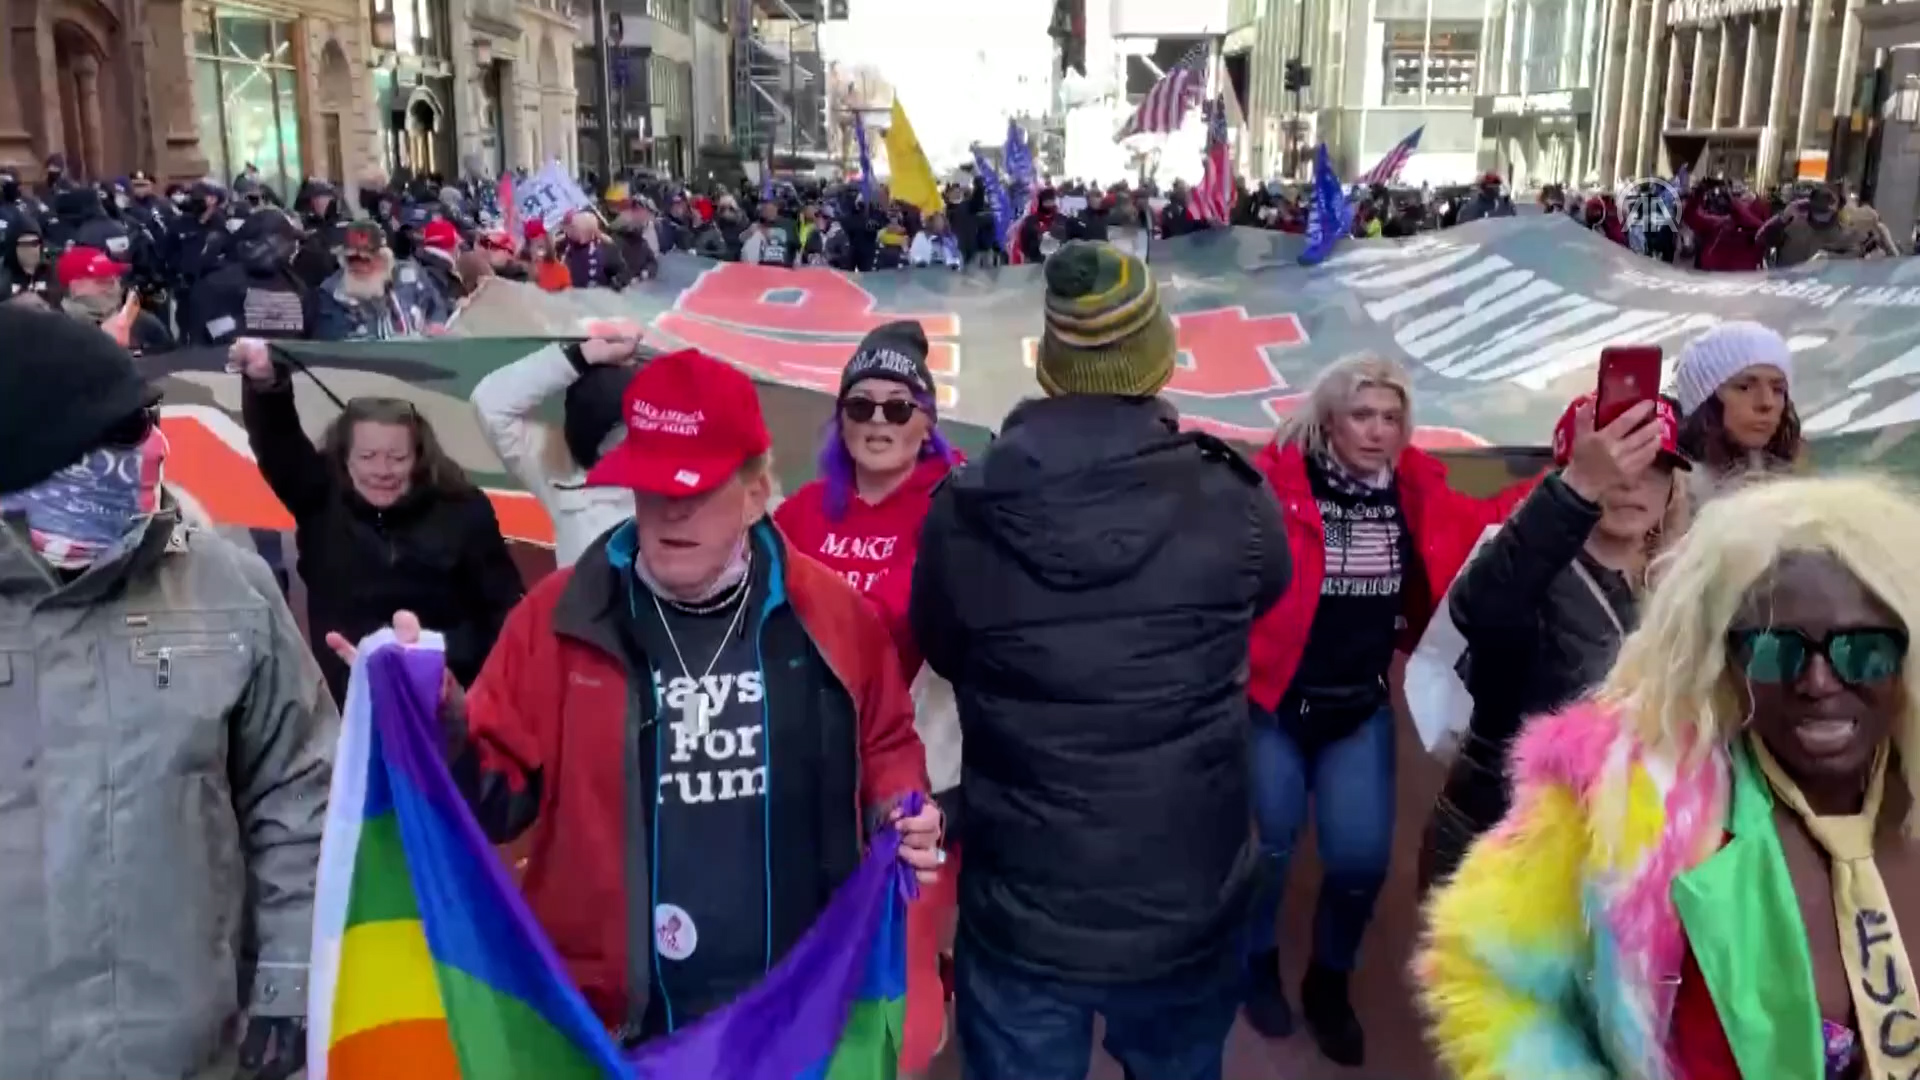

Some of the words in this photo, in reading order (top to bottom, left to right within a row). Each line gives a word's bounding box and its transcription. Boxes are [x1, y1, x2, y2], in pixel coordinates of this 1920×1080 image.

[669, 724, 763, 762] For
[657, 765, 767, 804] rum
[1855, 908, 1920, 1080] FUC
